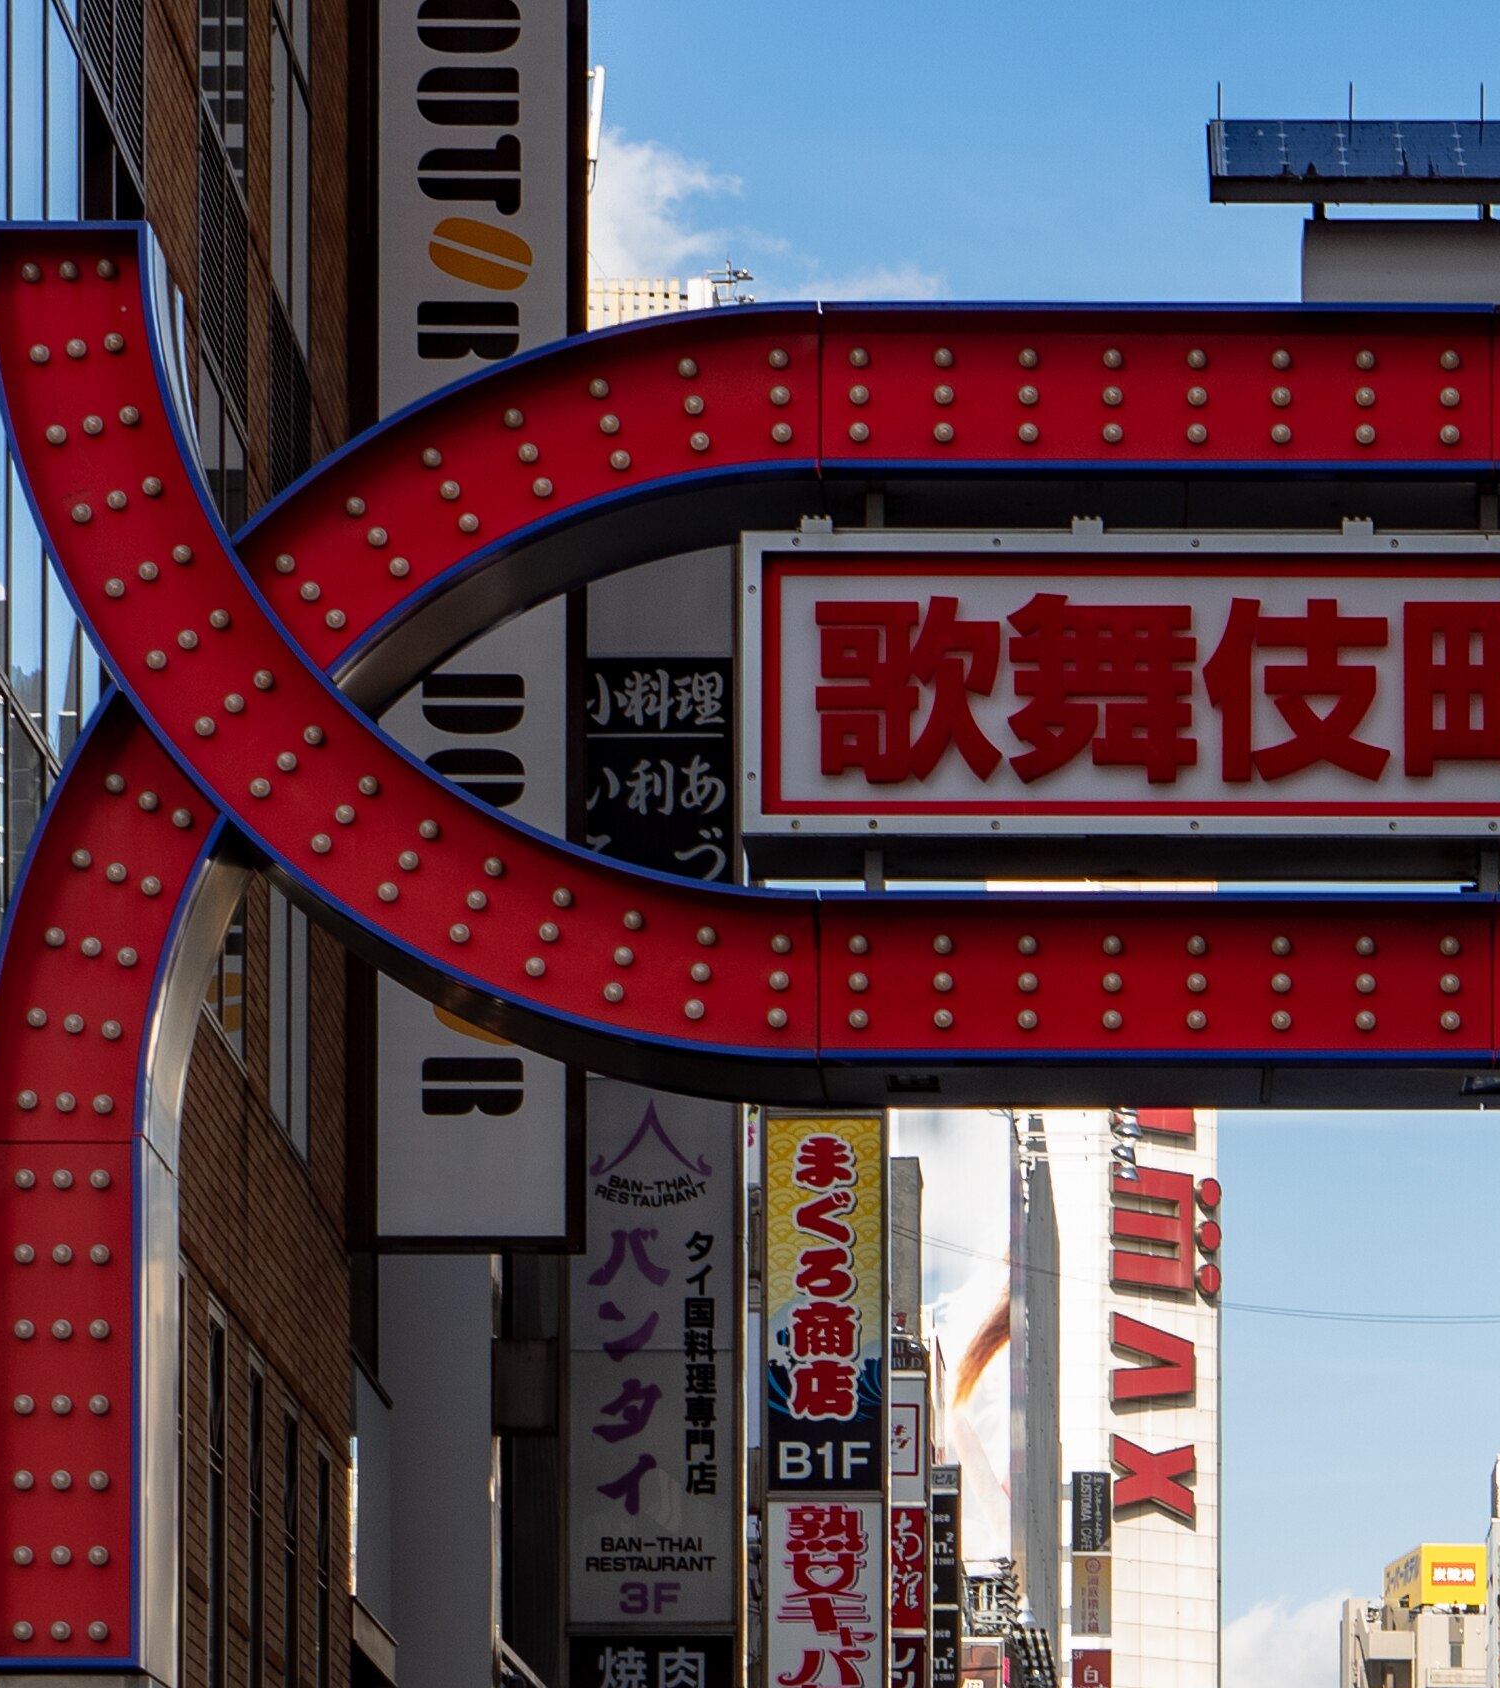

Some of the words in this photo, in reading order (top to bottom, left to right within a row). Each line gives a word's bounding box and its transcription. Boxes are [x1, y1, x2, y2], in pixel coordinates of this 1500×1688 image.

[594, 1183, 709, 1209] RESTAURANT
[607, 1174, 694, 1194] BAN-THAI
[790, 1132, 861, 1422] まぐろ商店
[587, 1229, 671, 1516] バンタイ
[684, 1231, 717, 1495] タイ国料理専門店
[778, 1442, 871, 1480] B1F
[601, 1537, 703, 1553] BAN-THAI
[586, 1556, 716, 1574] RESTAURANT
[619, 1582, 681, 1614] 3F
